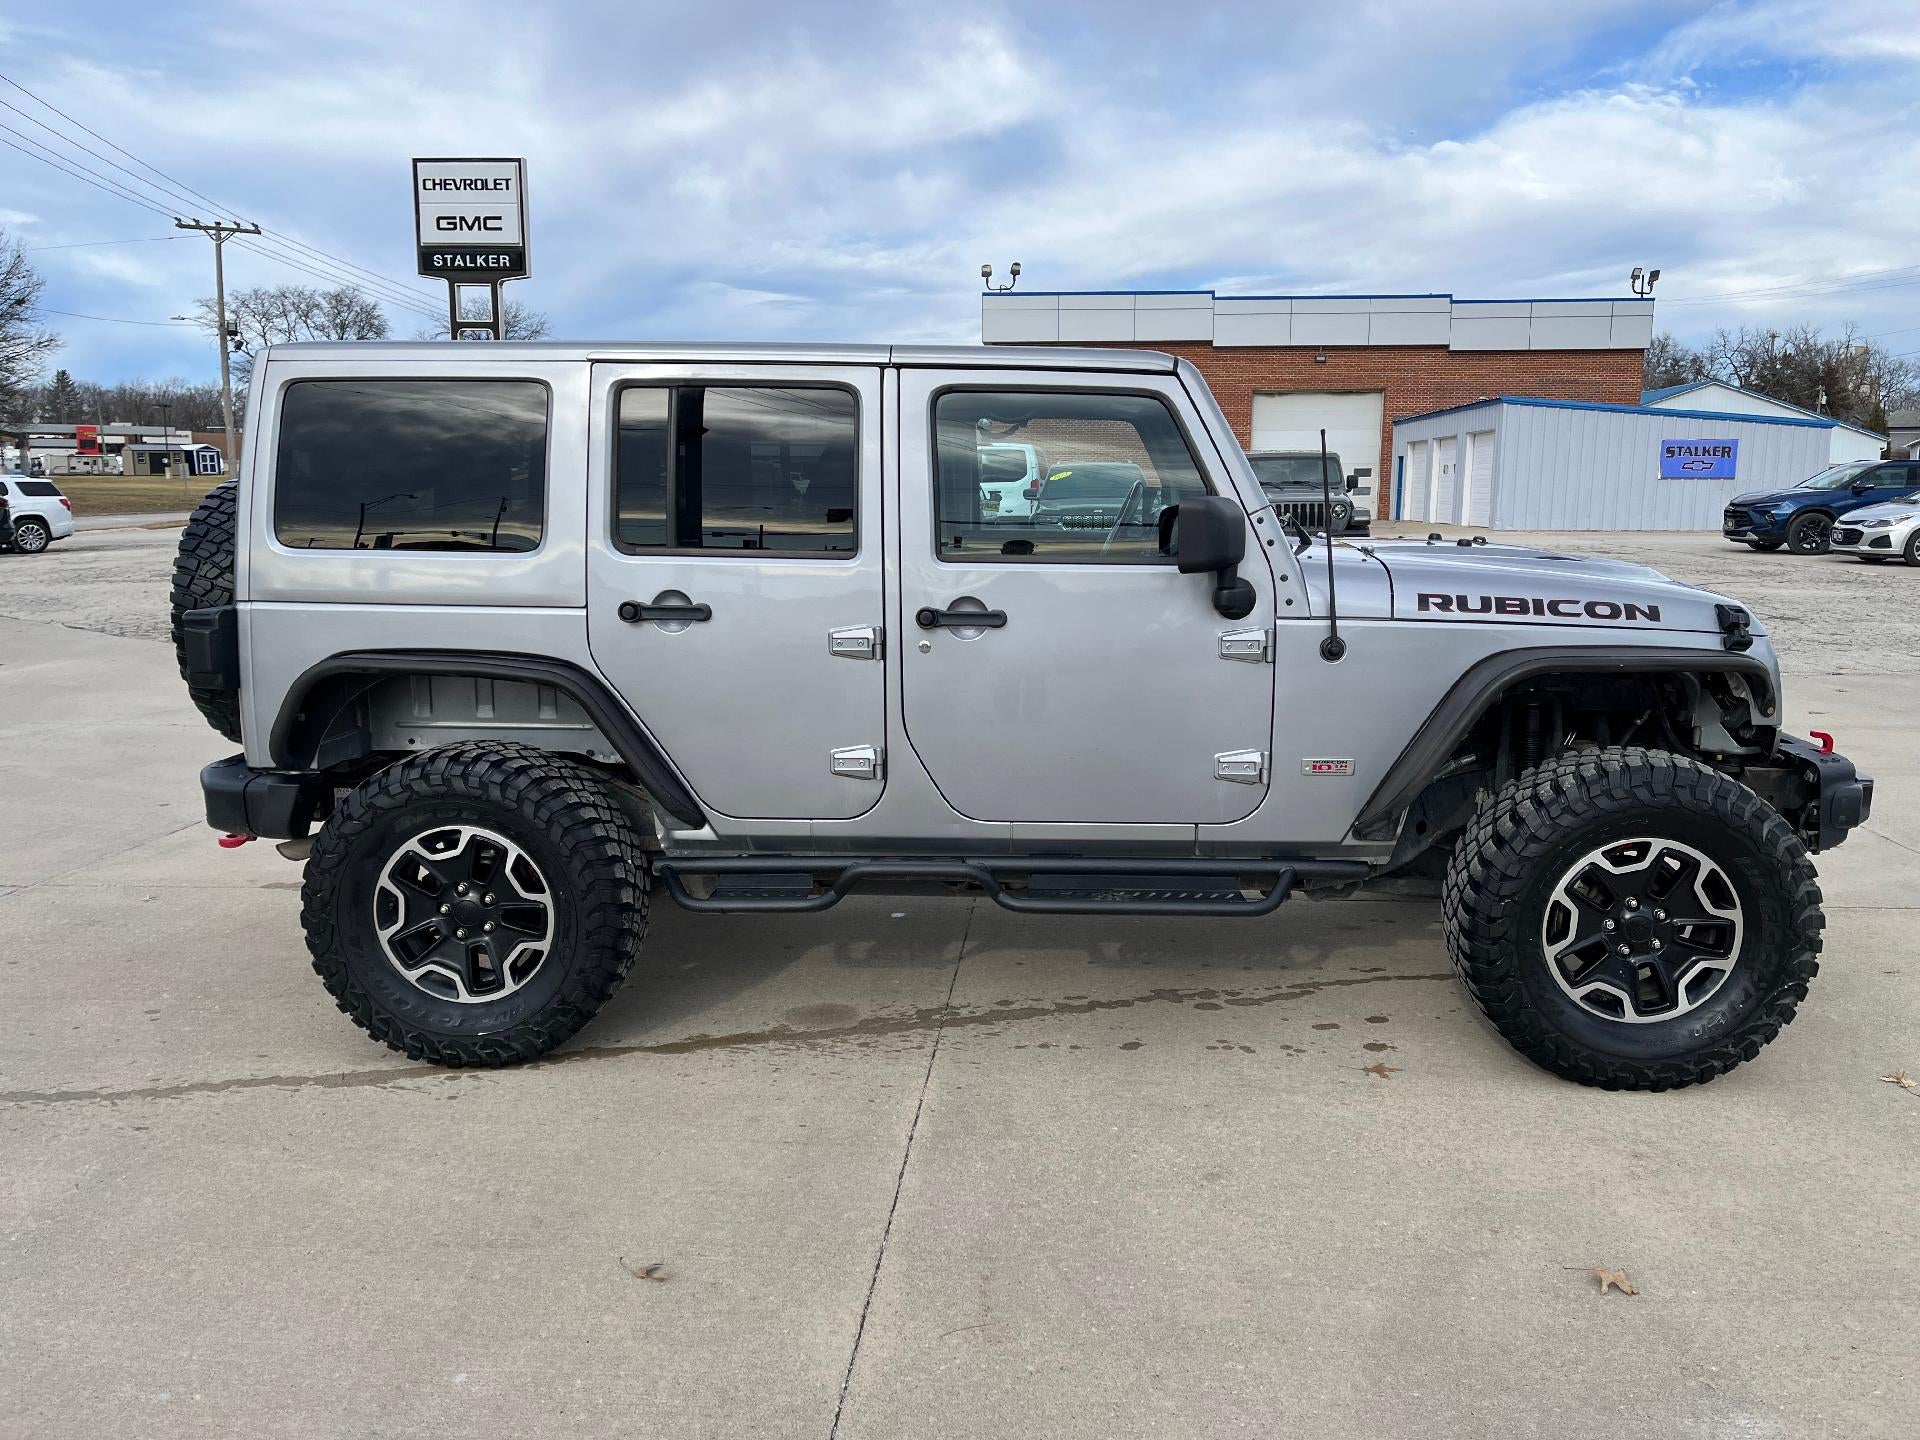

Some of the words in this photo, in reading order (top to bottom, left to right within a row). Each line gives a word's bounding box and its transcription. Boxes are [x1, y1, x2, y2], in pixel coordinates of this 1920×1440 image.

[422, 178, 512, 191] CHEVROLET
[435, 216, 503, 231] GMC
[433, 254, 511, 267] STALKER
[1665, 446, 1732, 458] STALKER
[1417, 593, 1662, 622] RUBICON
